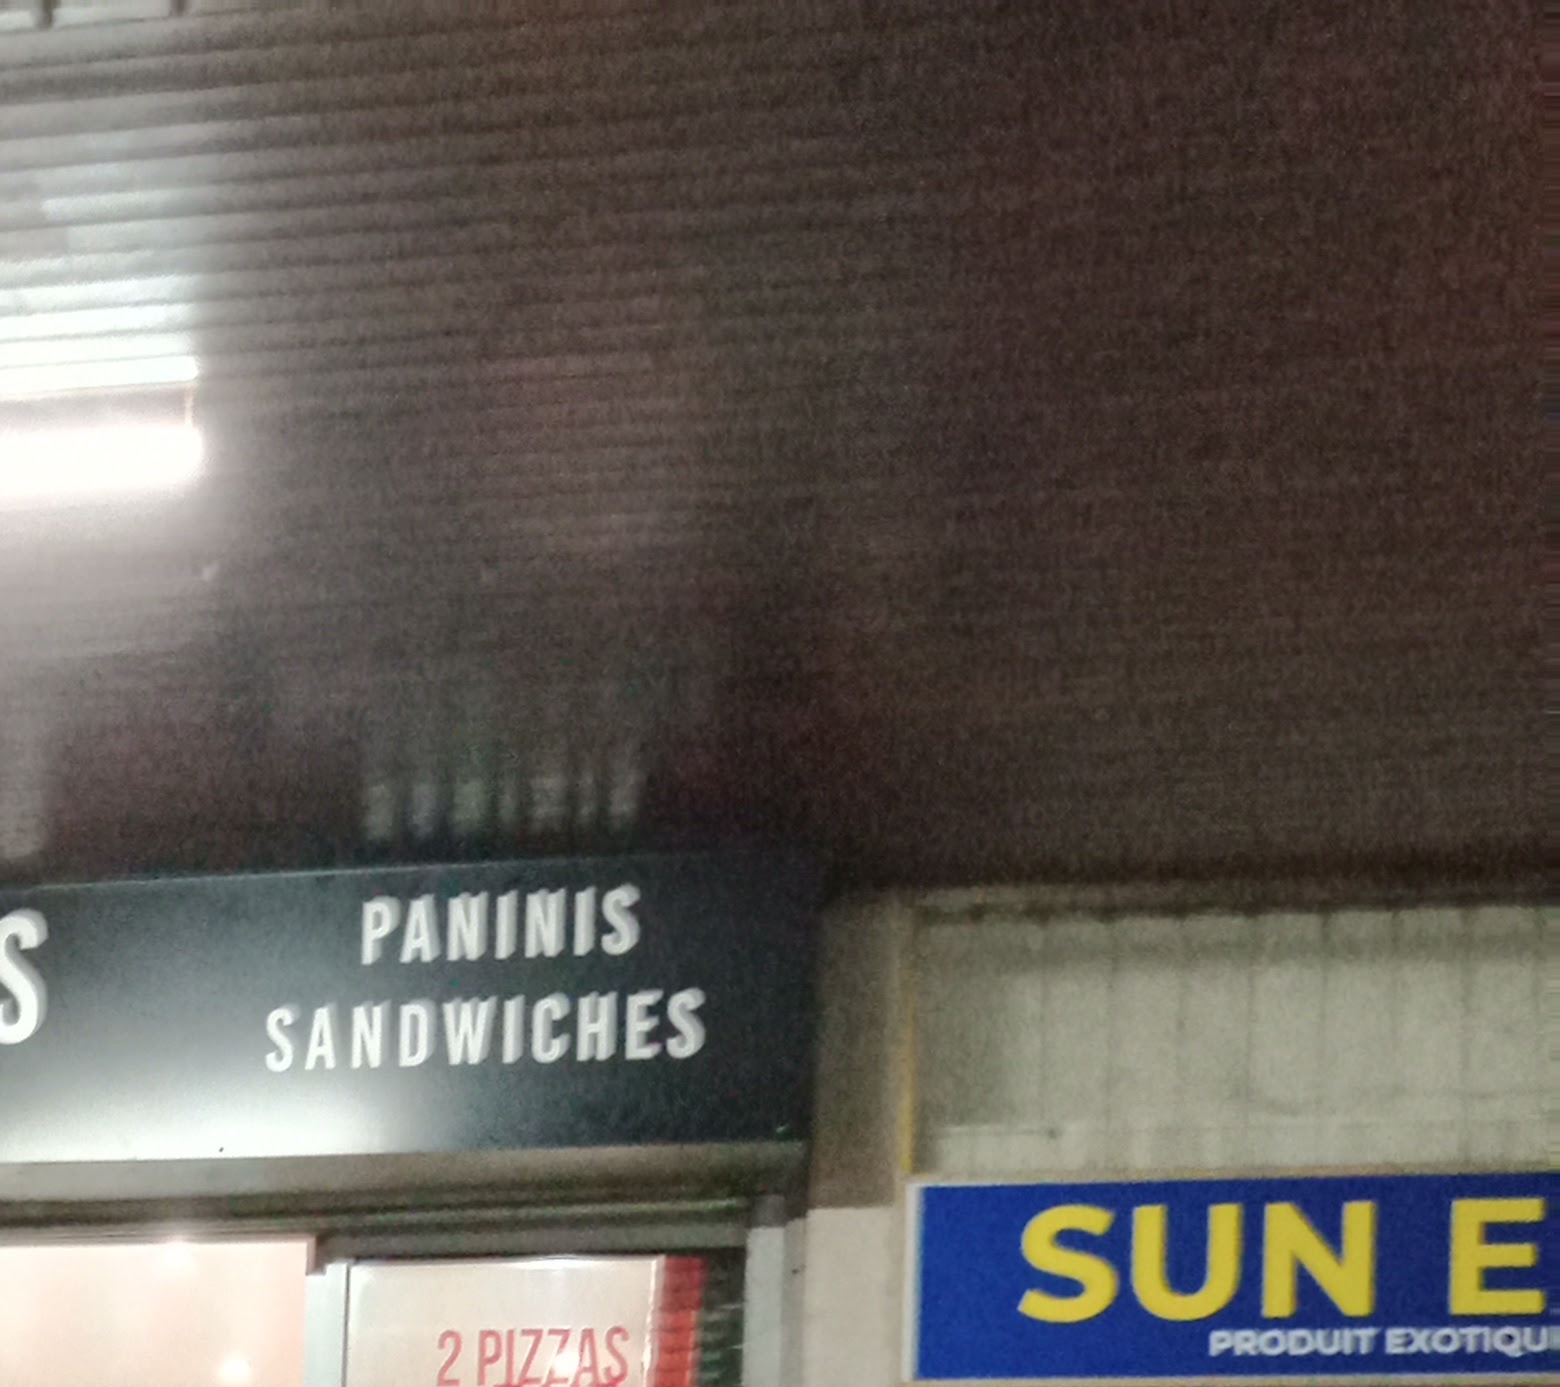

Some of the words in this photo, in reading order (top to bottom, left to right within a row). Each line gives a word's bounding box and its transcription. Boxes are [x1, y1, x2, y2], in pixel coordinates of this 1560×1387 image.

[362, 883, 640, 964] PANINIS
[265, 987, 706, 1072] SANDWICHES
[1017, 1201, 1377, 1323] SUN
[437, 1330, 463, 1387] 2
[477, 1326, 630, 1387] PIZZAS
[1209, 1327, 1382, 1357] PRODUIT
